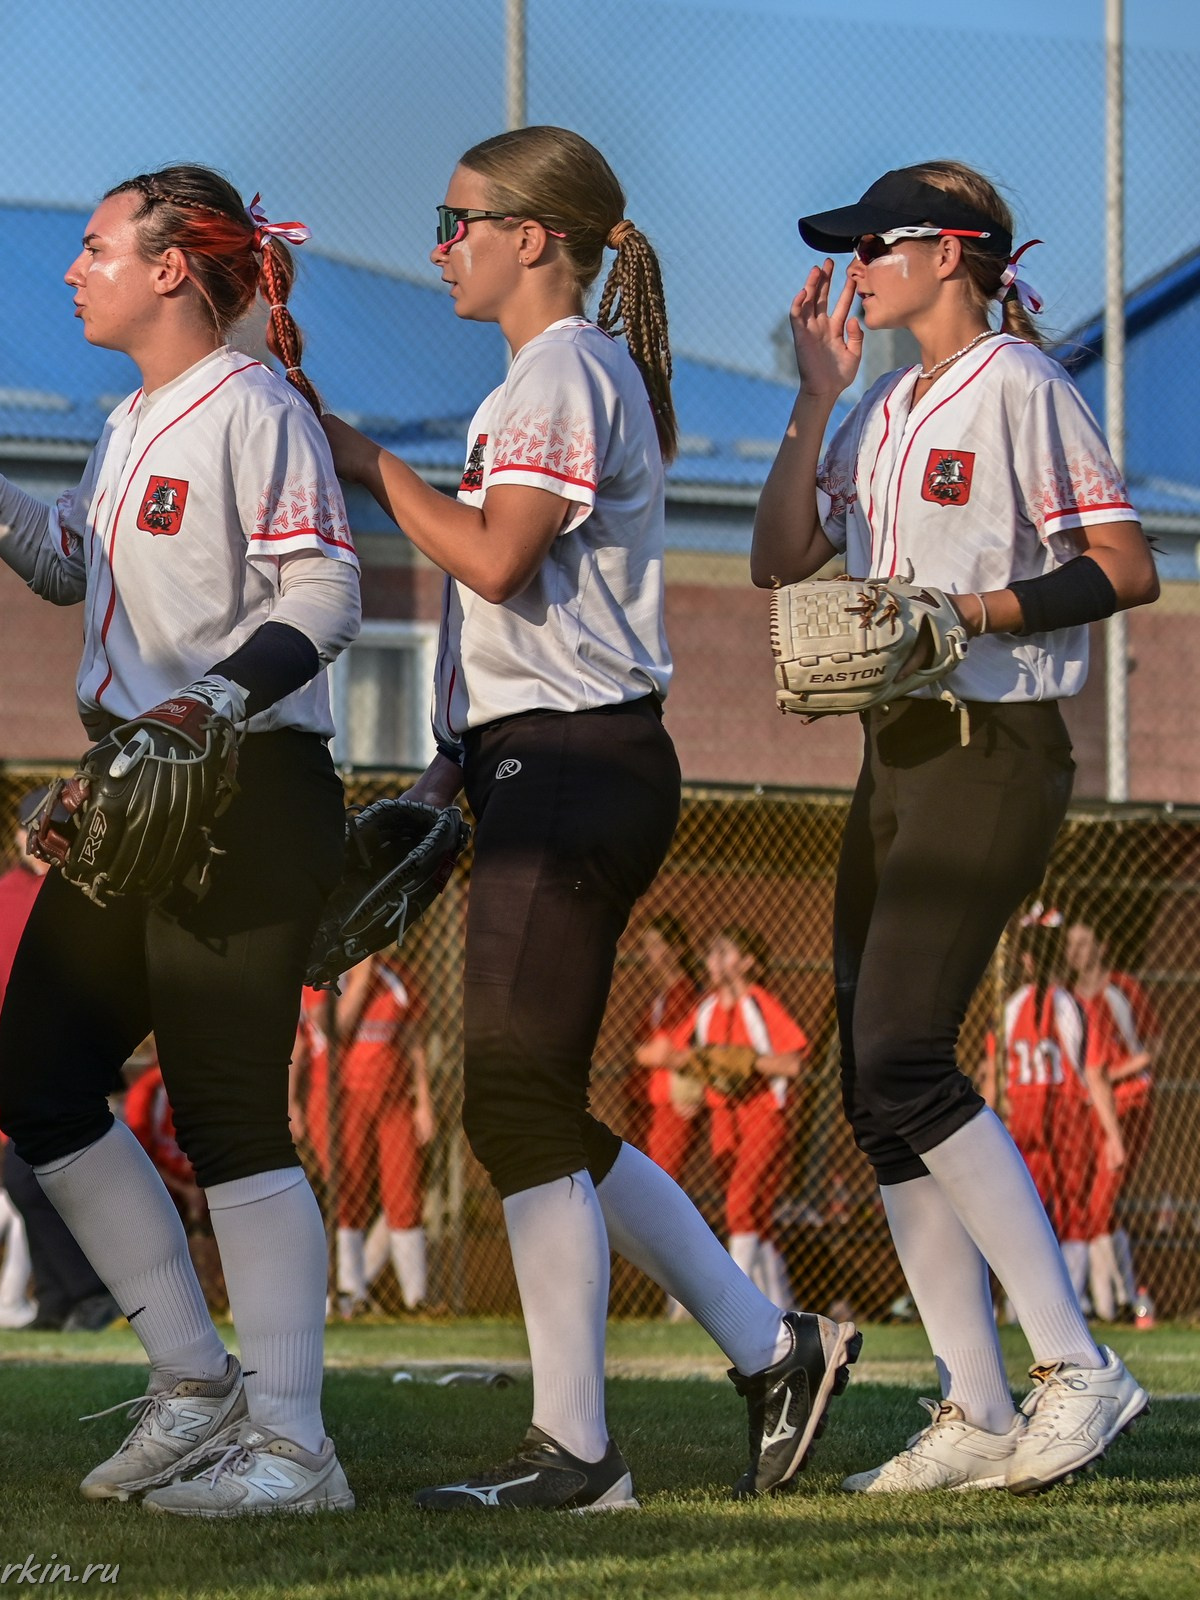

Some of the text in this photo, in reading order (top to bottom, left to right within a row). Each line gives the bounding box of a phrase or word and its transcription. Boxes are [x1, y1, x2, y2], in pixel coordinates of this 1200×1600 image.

[809, 665, 887, 684] EASTON
[77, 806, 108, 866] R9
[1014, 1039, 1064, 1085] 10
